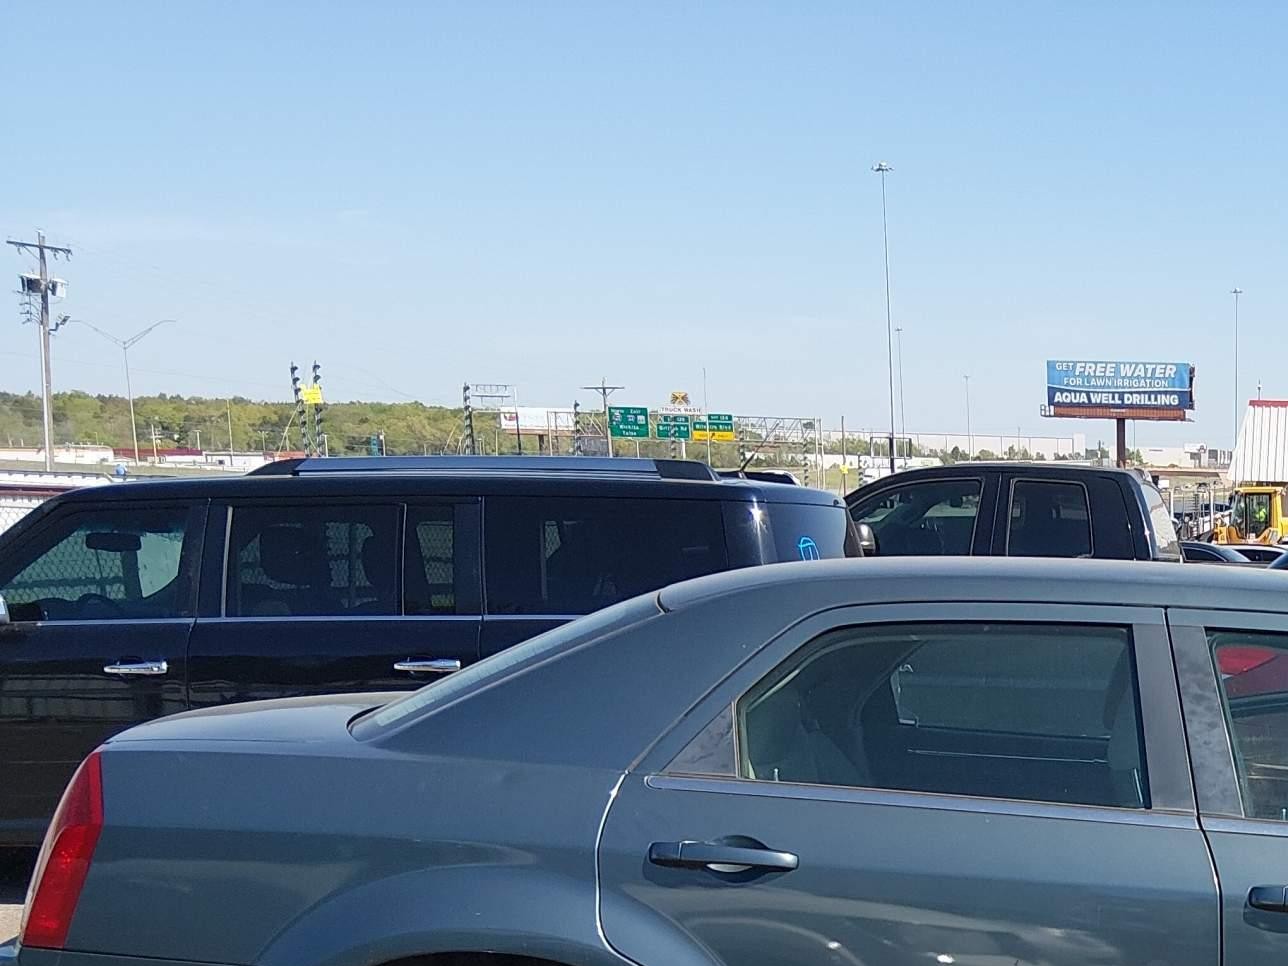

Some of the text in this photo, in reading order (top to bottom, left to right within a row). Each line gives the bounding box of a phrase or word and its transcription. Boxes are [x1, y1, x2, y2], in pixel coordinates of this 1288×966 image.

[1056, 363, 1177, 378] GET FREE WATER
[1063, 377, 1169, 388] FOR LAWN IRRIGATION
[1054, 391, 1179, 405] AQUA WELL DRILLING
